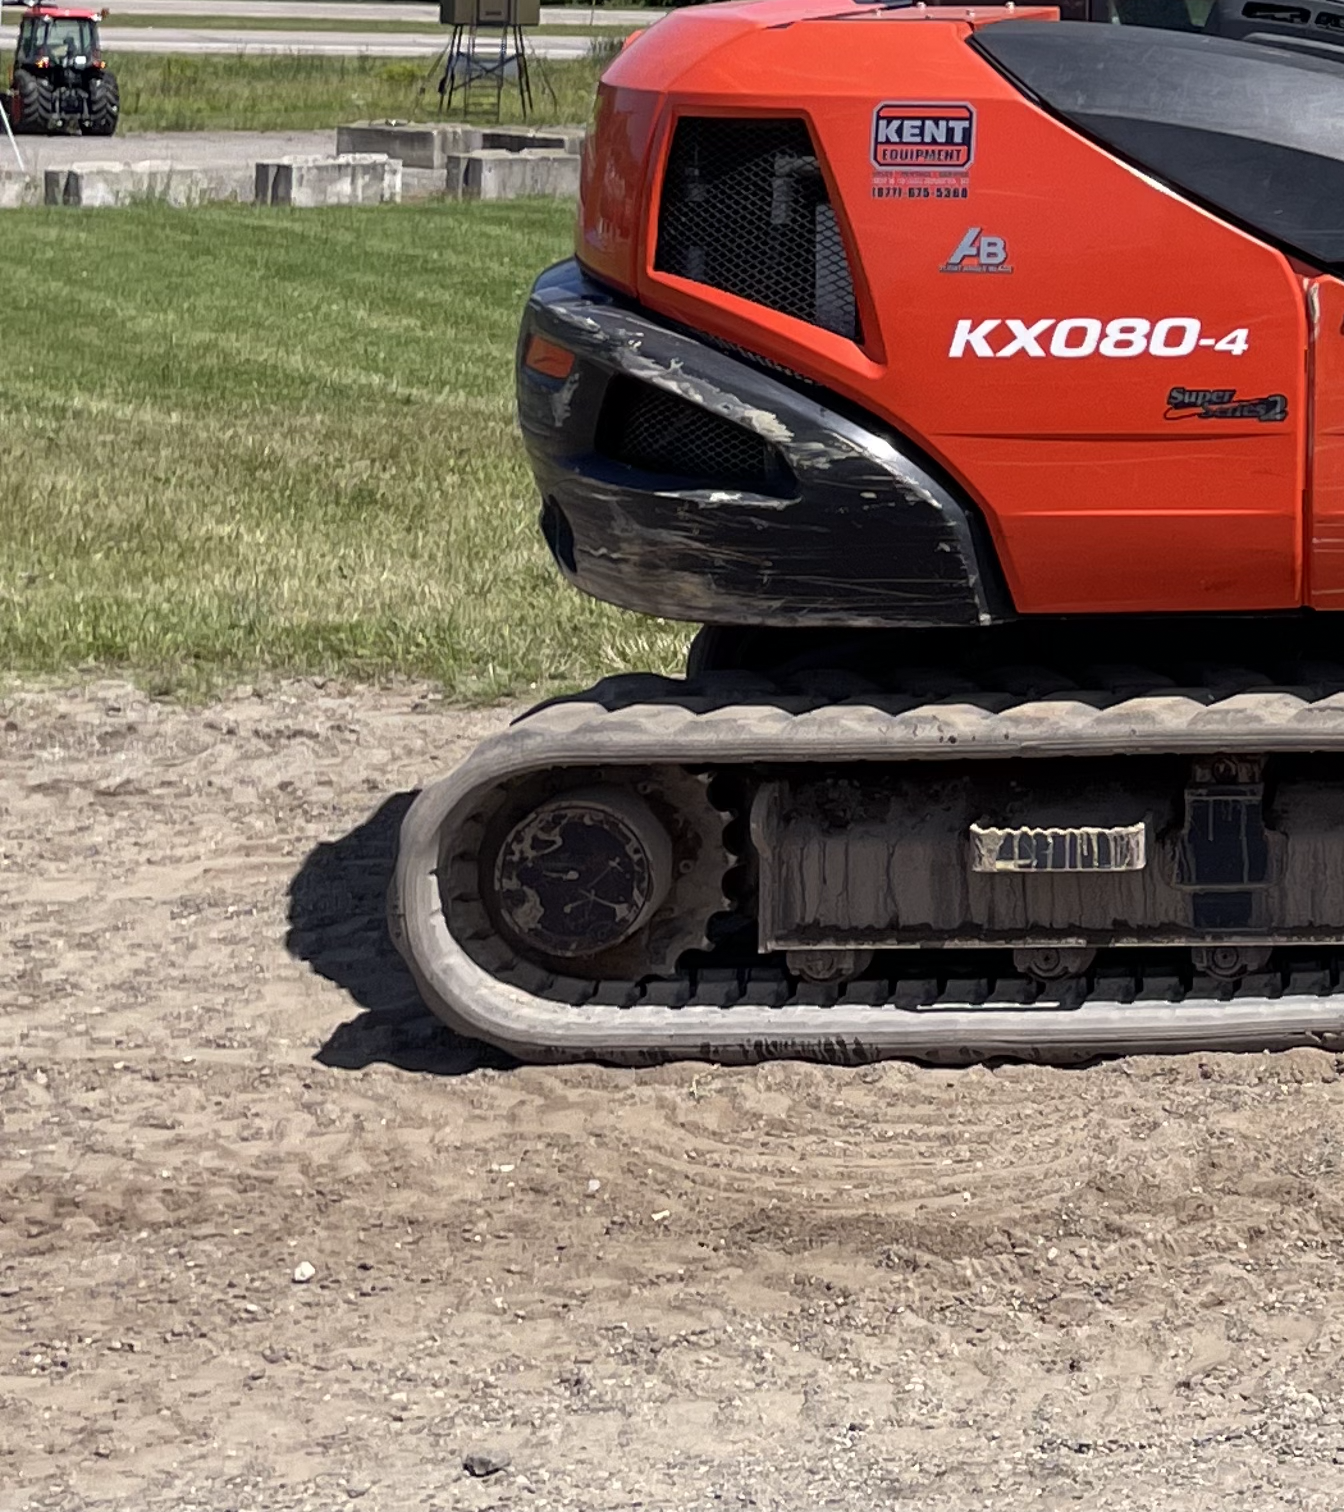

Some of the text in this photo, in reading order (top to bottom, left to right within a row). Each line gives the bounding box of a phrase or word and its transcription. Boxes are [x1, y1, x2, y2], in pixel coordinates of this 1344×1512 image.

[877, 119, 970, 143] KENT
[882, 148, 962, 163] EQUIPMENT
[948, 227, 1008, 265] AB
[948, 317, 1250, 358] KX080-4
[1169, 388, 1235, 406] Super
